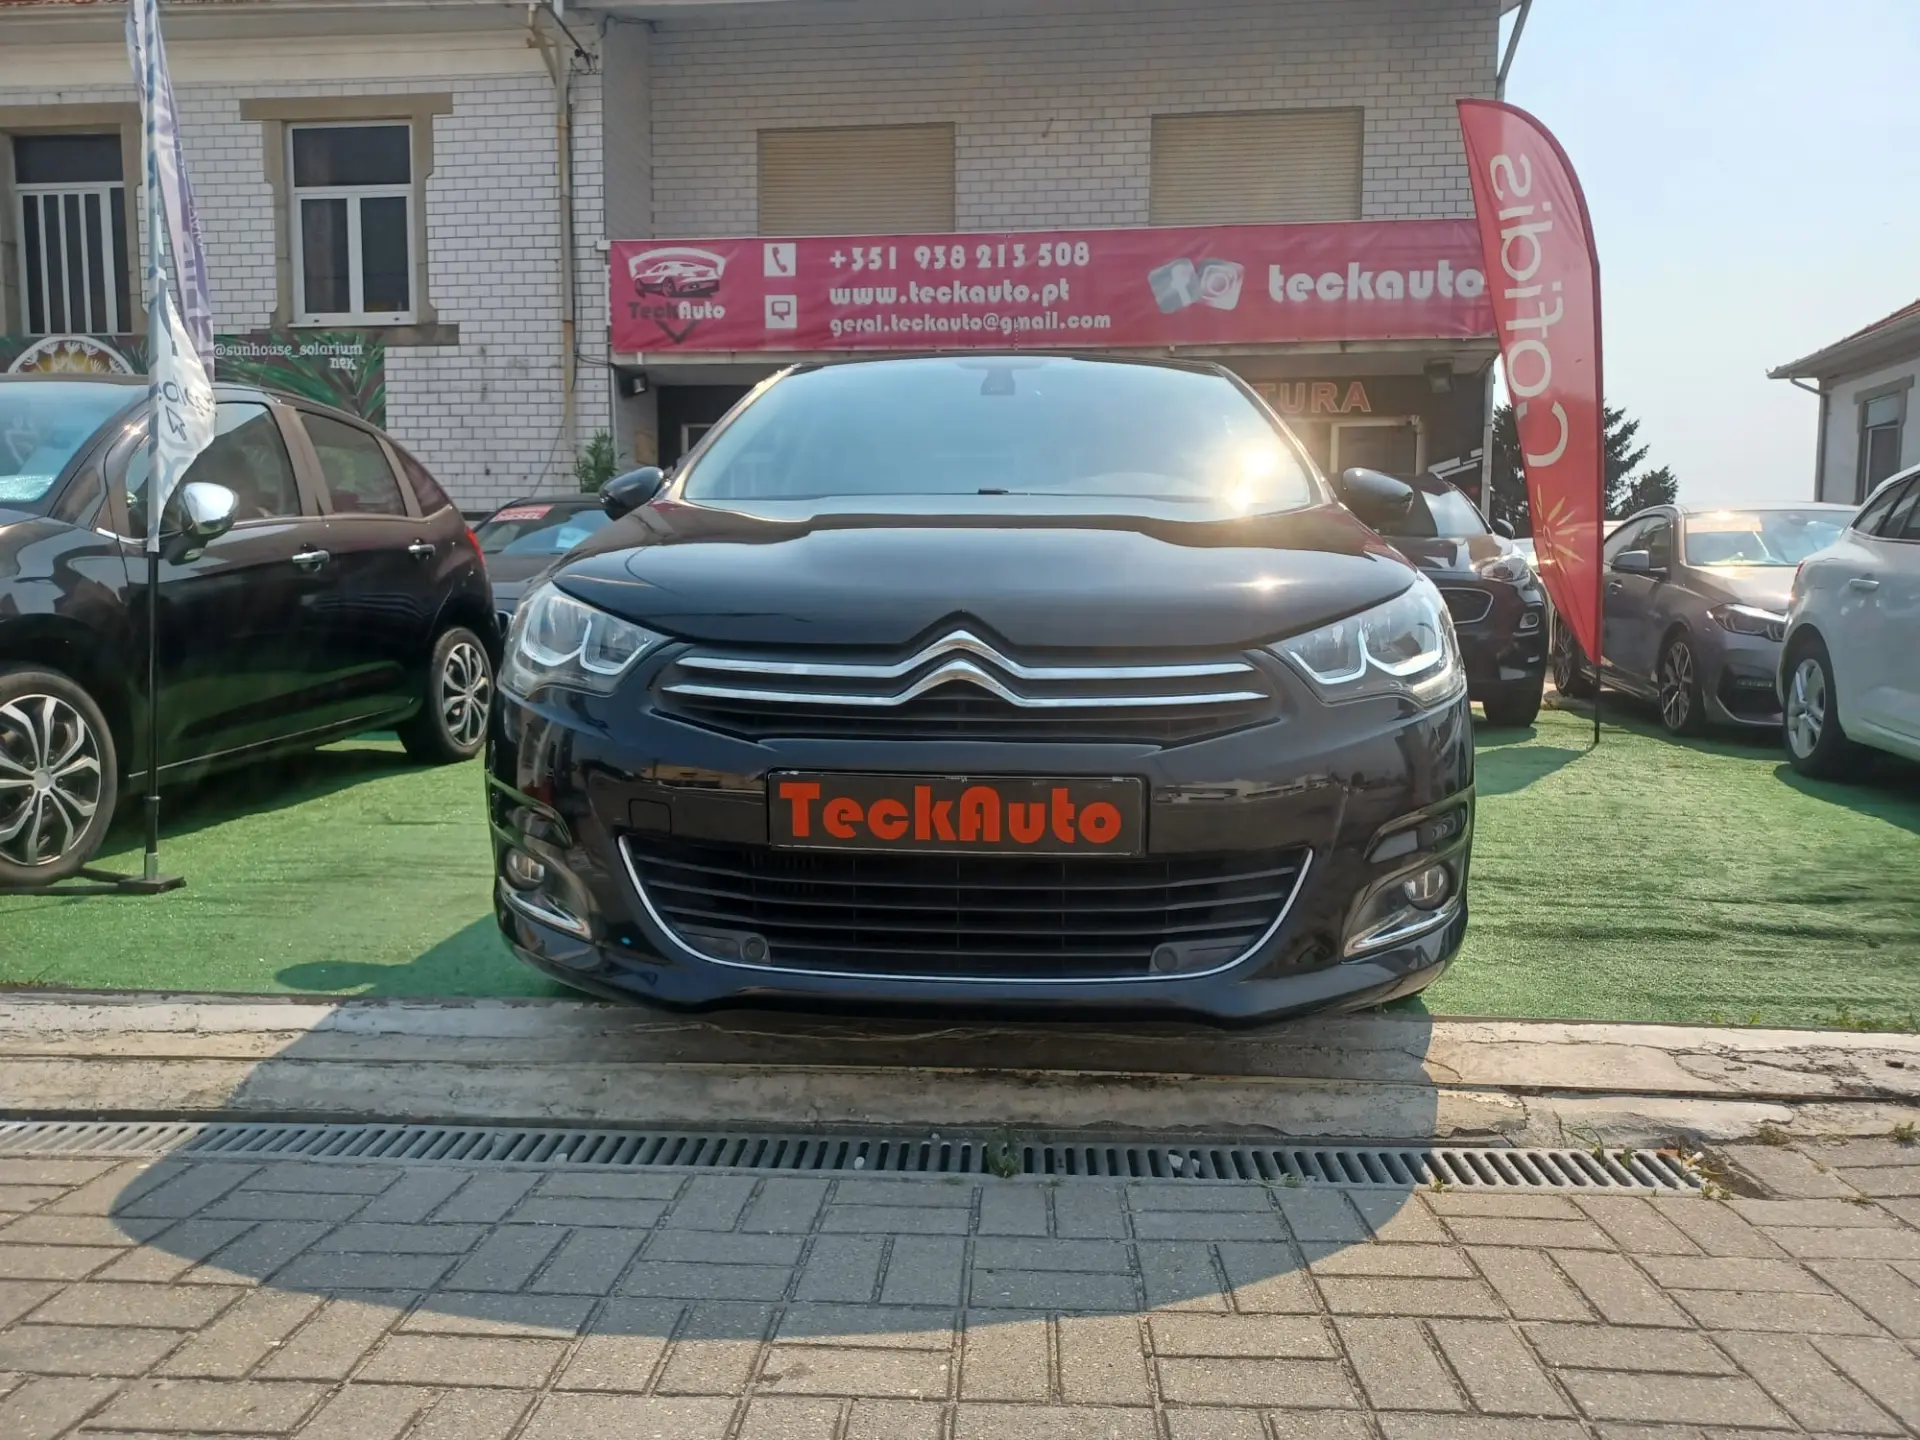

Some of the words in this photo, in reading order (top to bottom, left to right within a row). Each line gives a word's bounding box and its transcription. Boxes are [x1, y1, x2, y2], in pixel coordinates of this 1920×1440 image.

[829, 247, 897, 271] +351
[914, 245, 966, 270] 938
[976, 244, 1026, 268] 213
[1038, 242, 1090, 267] 508
[829, 278, 1070, 307] www.teckauto.pt
[1268, 259, 1486, 303] teckauto
[628, 301, 726, 320] TeckAuto
[829, 311, 1112, 337] geral.teckauto@gmail.com
[213, 341, 364, 360] @sunhouse_solarium
[779, 781, 1122, 844] TeckAuto
